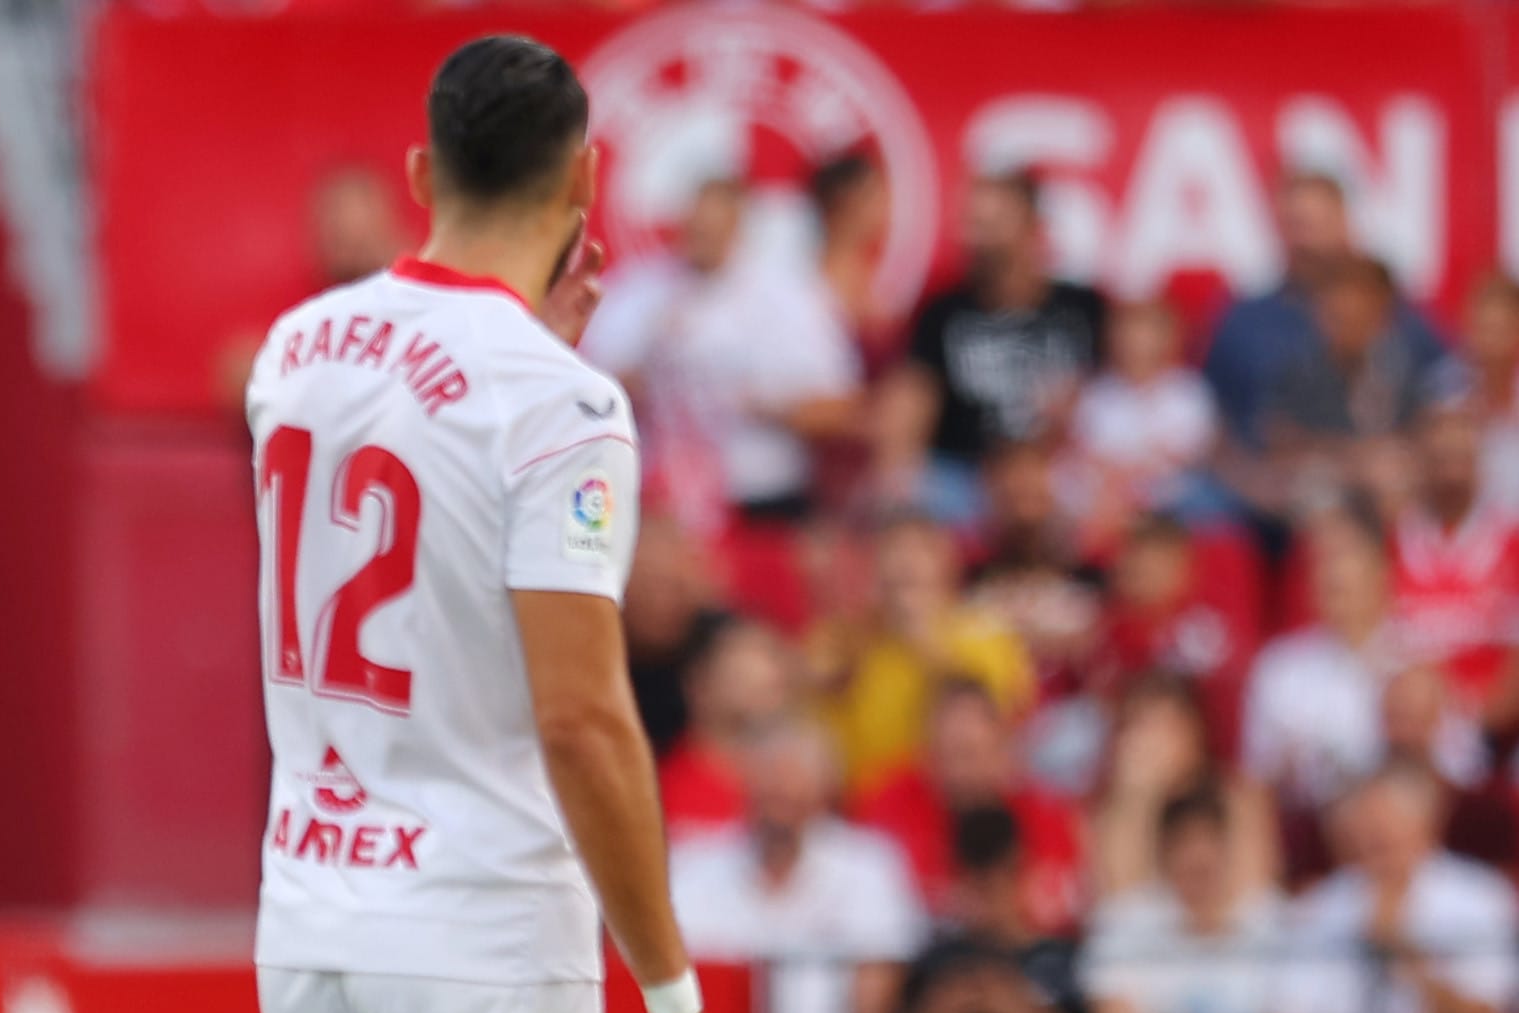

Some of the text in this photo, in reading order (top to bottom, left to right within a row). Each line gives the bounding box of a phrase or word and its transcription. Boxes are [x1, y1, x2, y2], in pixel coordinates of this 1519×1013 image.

[282, 314, 469, 417] RAFA MIR
[257, 423, 421, 718] 12
